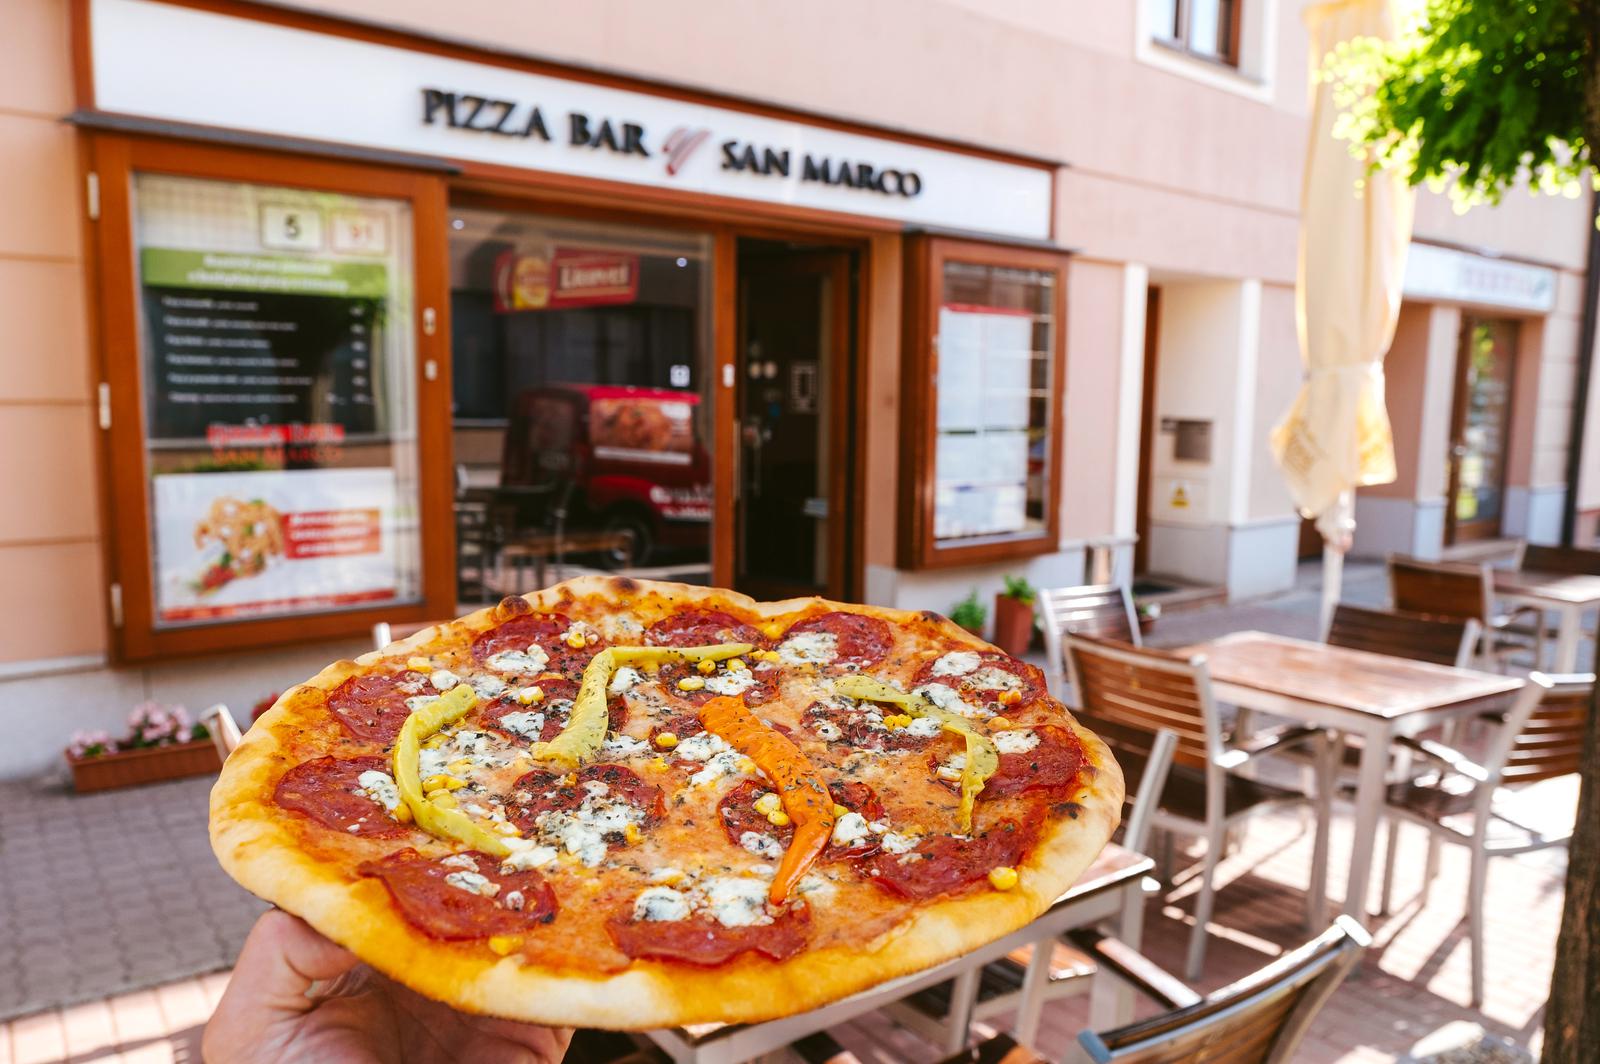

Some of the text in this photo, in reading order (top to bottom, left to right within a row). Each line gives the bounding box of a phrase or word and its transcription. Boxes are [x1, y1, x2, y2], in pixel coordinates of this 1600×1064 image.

[422, 88, 922, 197] PIZZA BAR SAN MARCO
